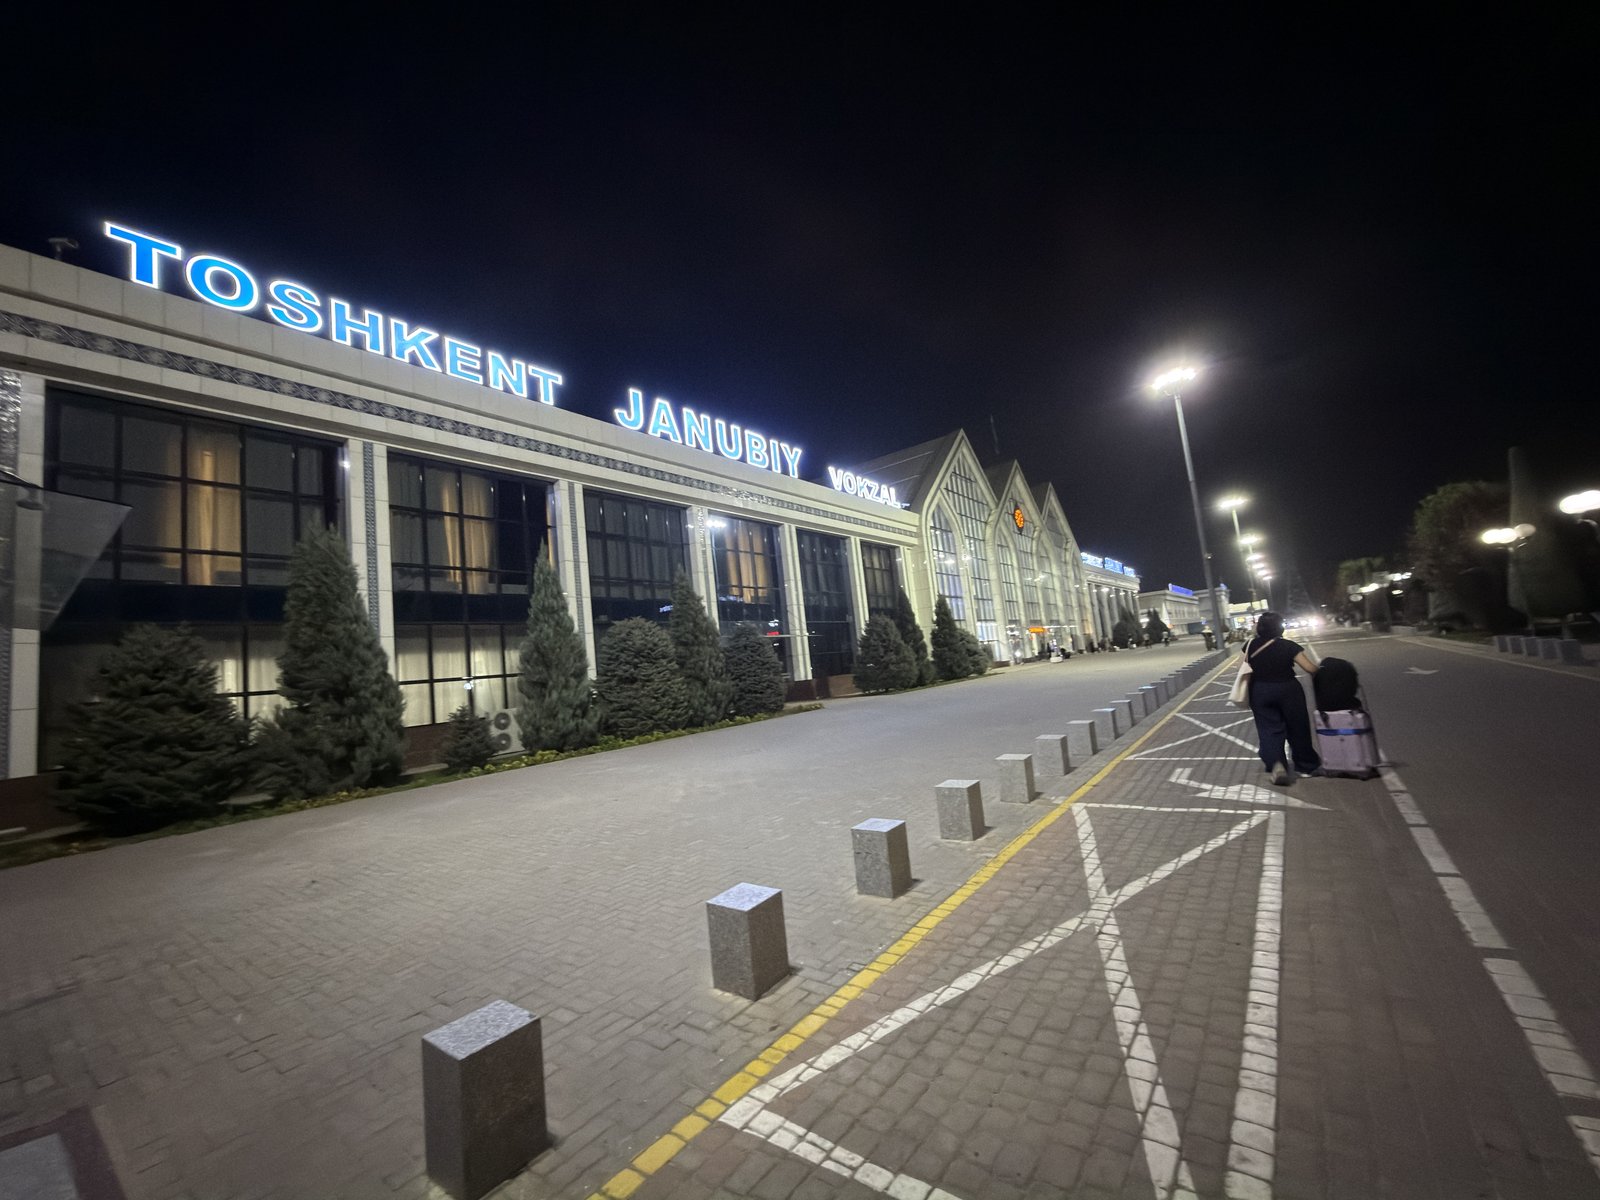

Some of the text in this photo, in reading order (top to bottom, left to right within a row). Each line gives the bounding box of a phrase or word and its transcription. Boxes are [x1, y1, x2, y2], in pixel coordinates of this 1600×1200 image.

[105, 221, 901, 508] TOSHKENT JANUBIY VOKZAL
